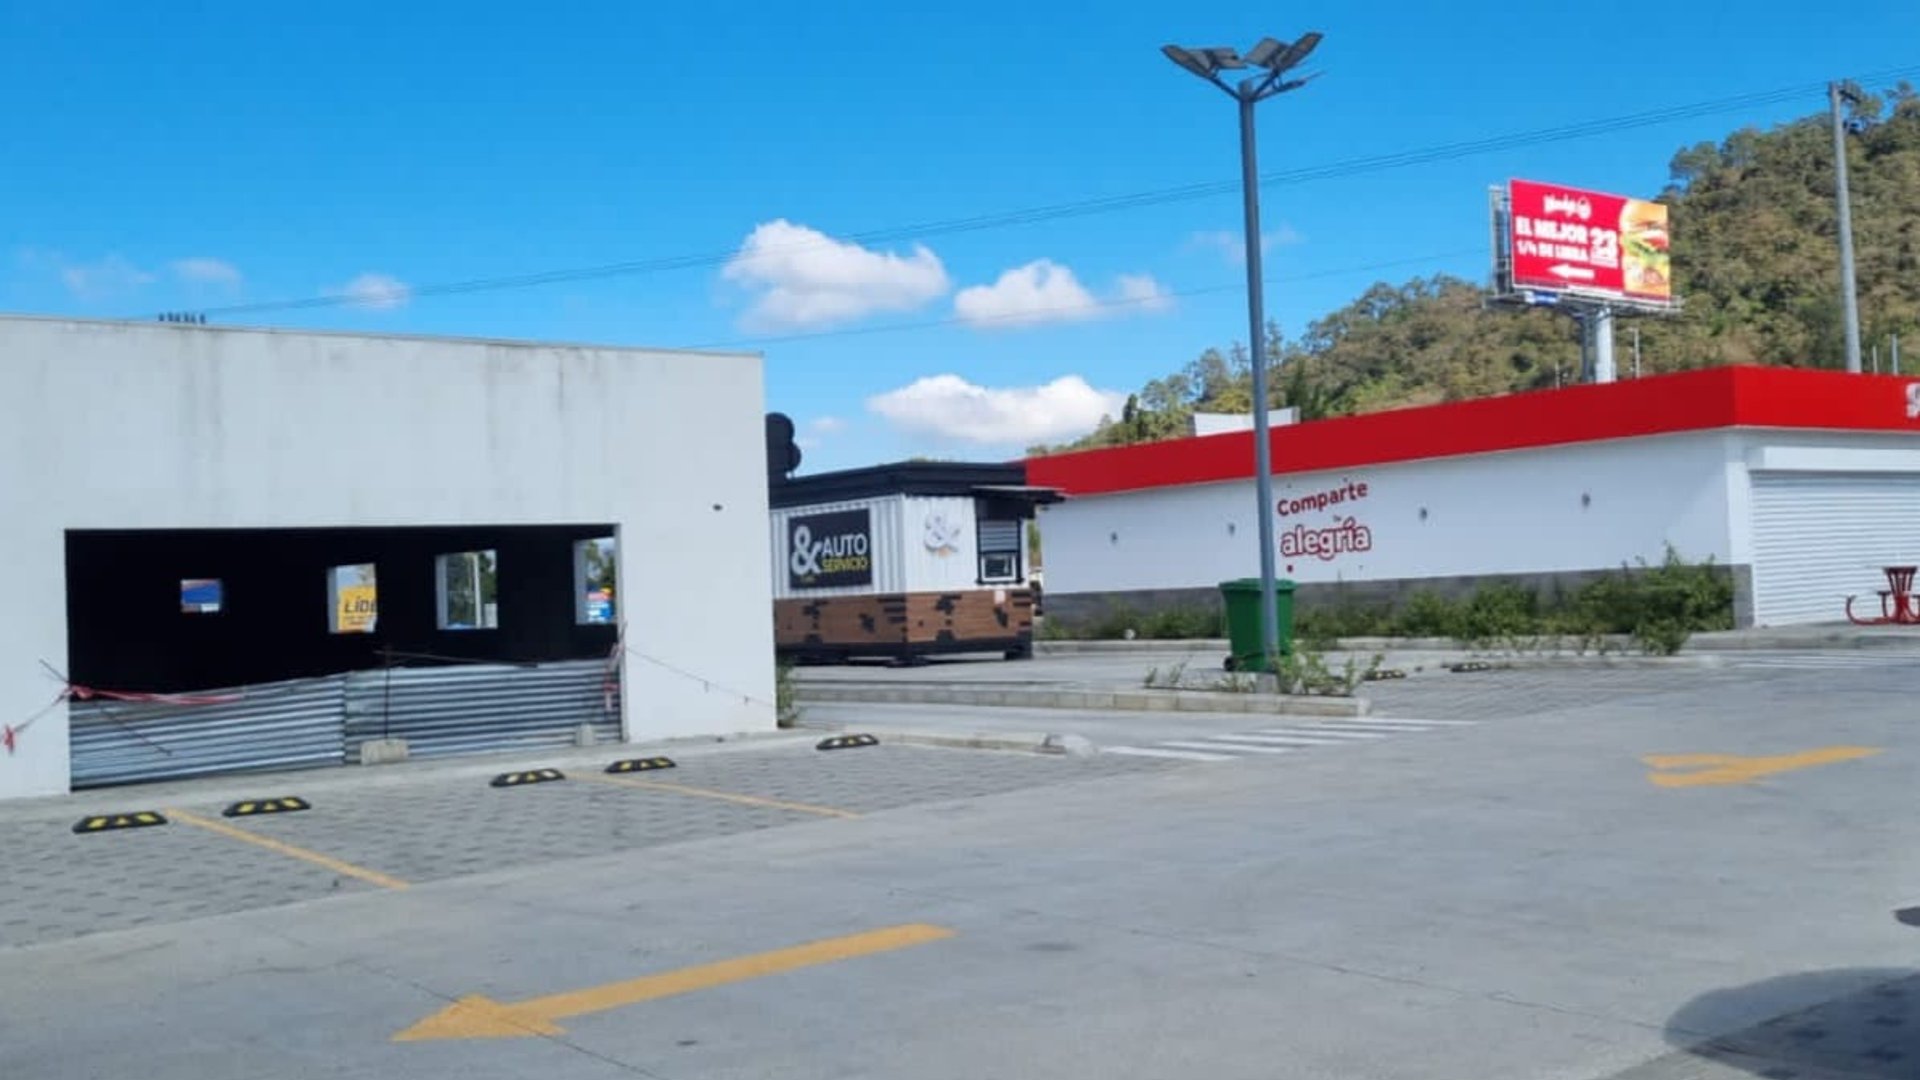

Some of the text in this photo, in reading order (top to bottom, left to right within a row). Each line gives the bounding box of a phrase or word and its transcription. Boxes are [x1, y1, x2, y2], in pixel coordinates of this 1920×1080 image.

[1534, 219, 1588, 244] MEJOR
[1277, 482, 1368, 517] Comparte
[822, 533, 867, 557] AUTO
[1280, 516, 1372, 561] alegría
